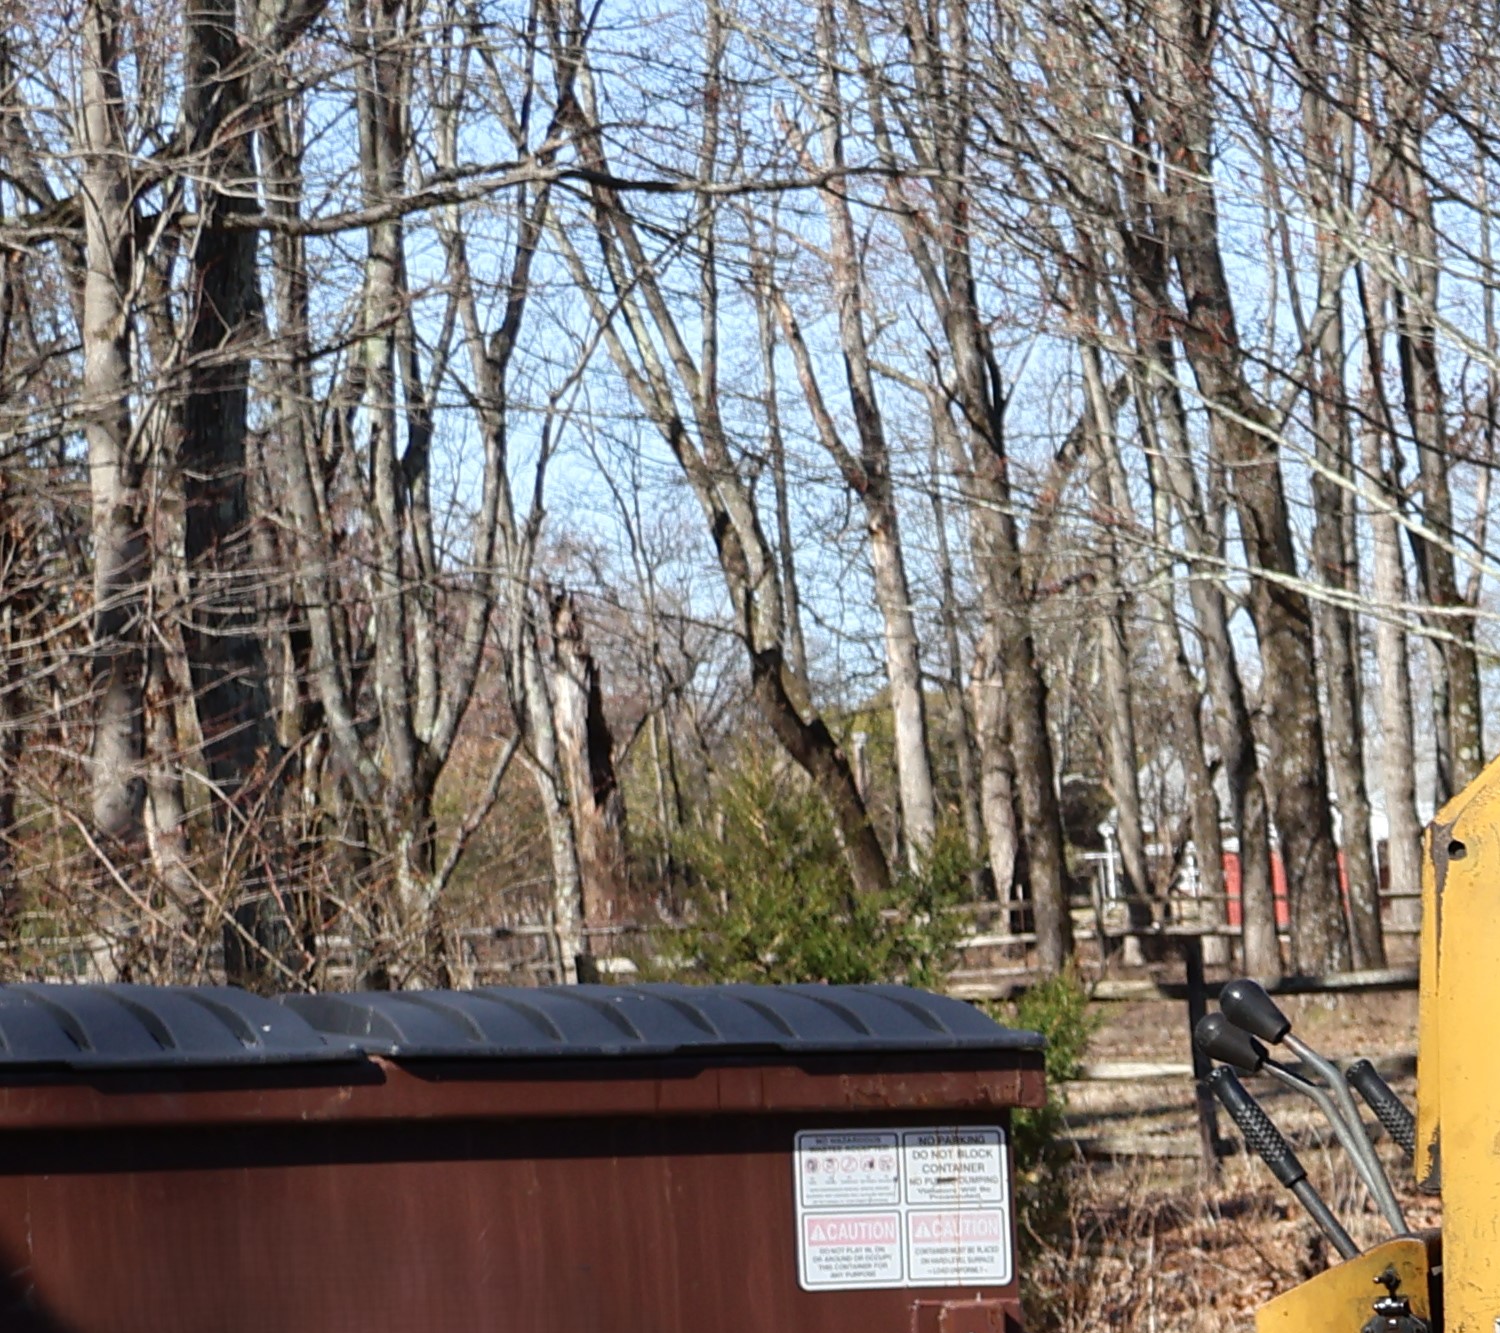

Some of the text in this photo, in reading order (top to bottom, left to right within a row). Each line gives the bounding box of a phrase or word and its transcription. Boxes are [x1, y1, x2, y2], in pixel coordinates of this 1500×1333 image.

[919, 1135, 986, 1146] NO PARKING
[912, 1148, 993, 1160] DO NOT BLOCK
[922, 1162, 985, 1174] CONTAINER
[909, 1178, 922, 1186] NO
[827, 1221, 895, 1241] CAUTION
[932, 1218, 999, 1238] CAUTION
